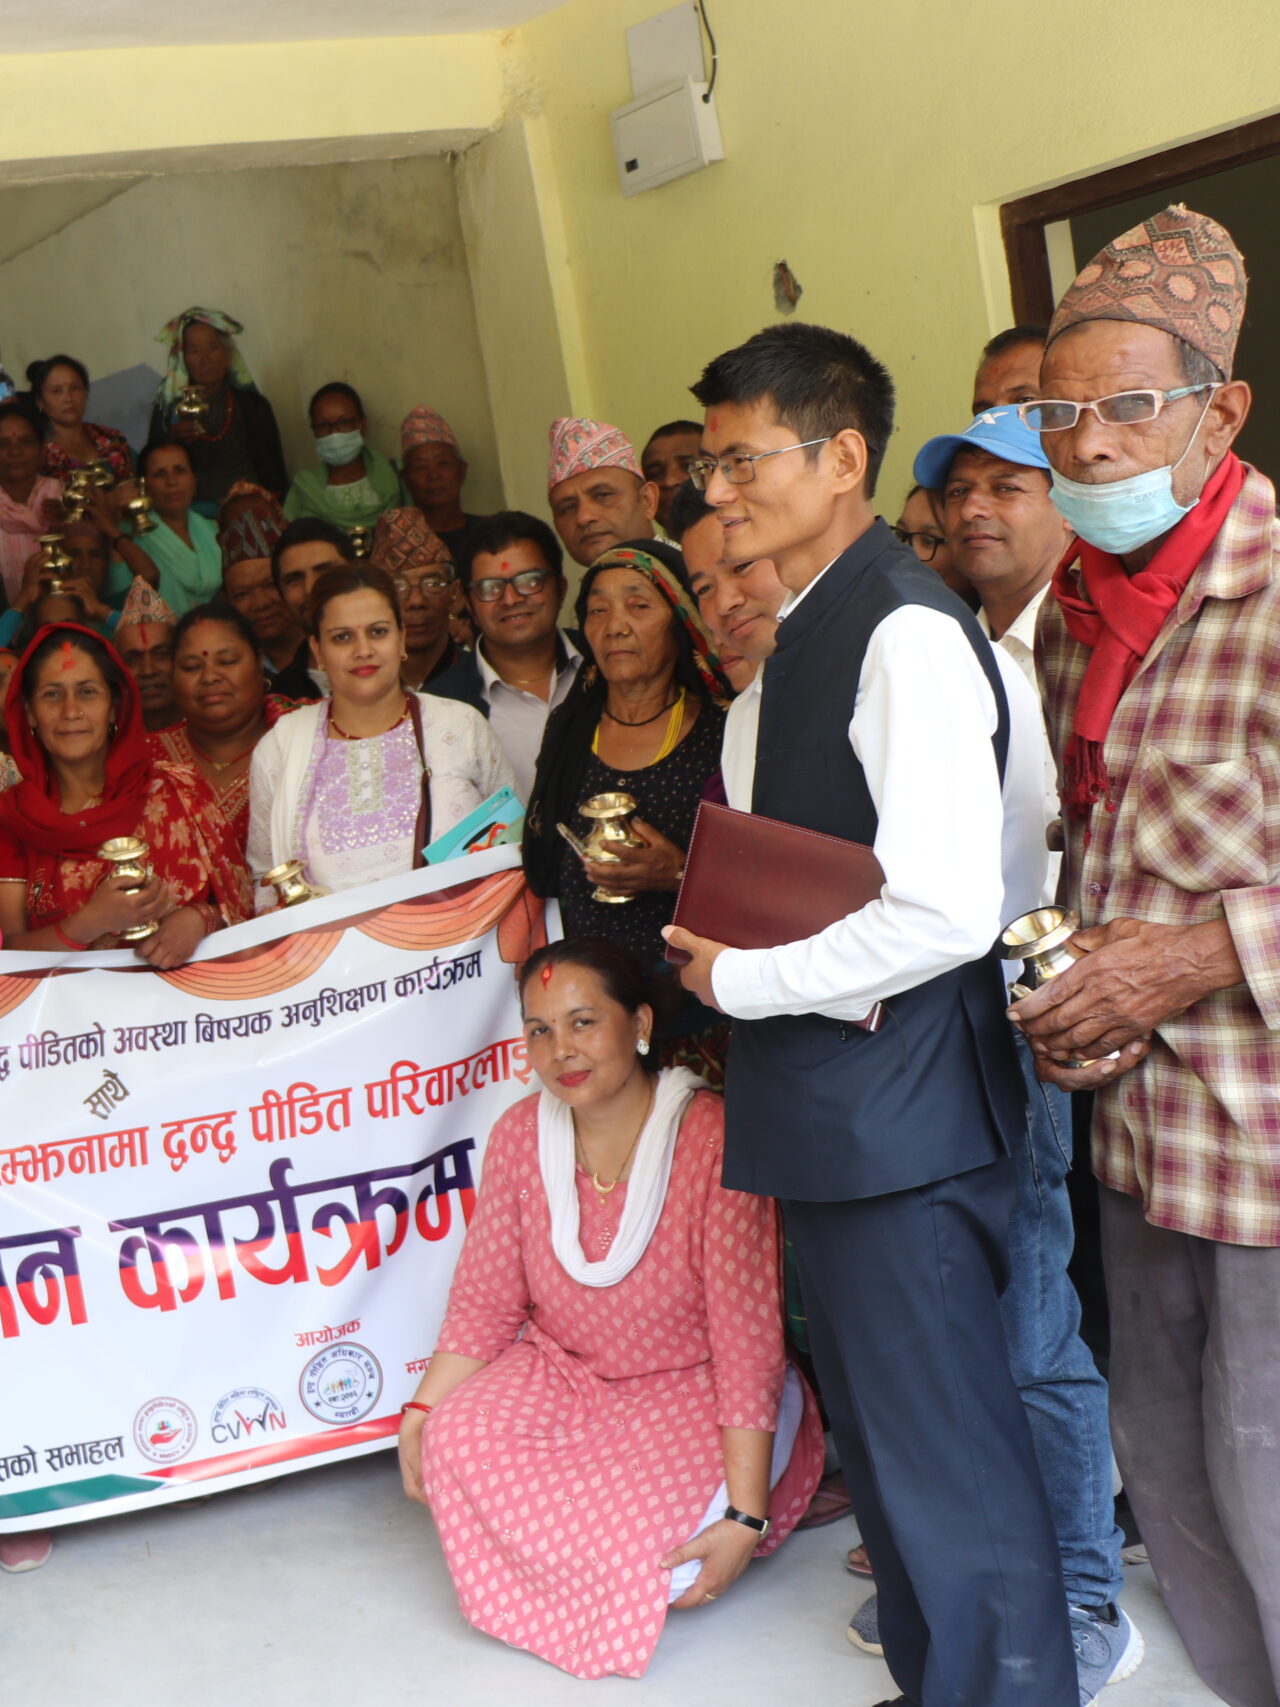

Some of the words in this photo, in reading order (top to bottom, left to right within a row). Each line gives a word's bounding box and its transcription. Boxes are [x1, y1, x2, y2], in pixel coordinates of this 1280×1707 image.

[19, 1022, 106, 1070] पीडितको
[114, 1019, 187, 1053] अवस्था
[195, 1012, 273, 1043] बिषयक
[280, 980, 387, 1027] अनुशिक्षण
[394, 949, 483, 998] कार्यक्रम
[83, 1069, 131, 1120] साथै
[249, 1081, 353, 1143] पीडित
[107, 1137, 477, 1312] कार्यक्रम
[294, 1317, 361, 1347] आयोजक
[44, 1436, 125, 1472] सभाहल
